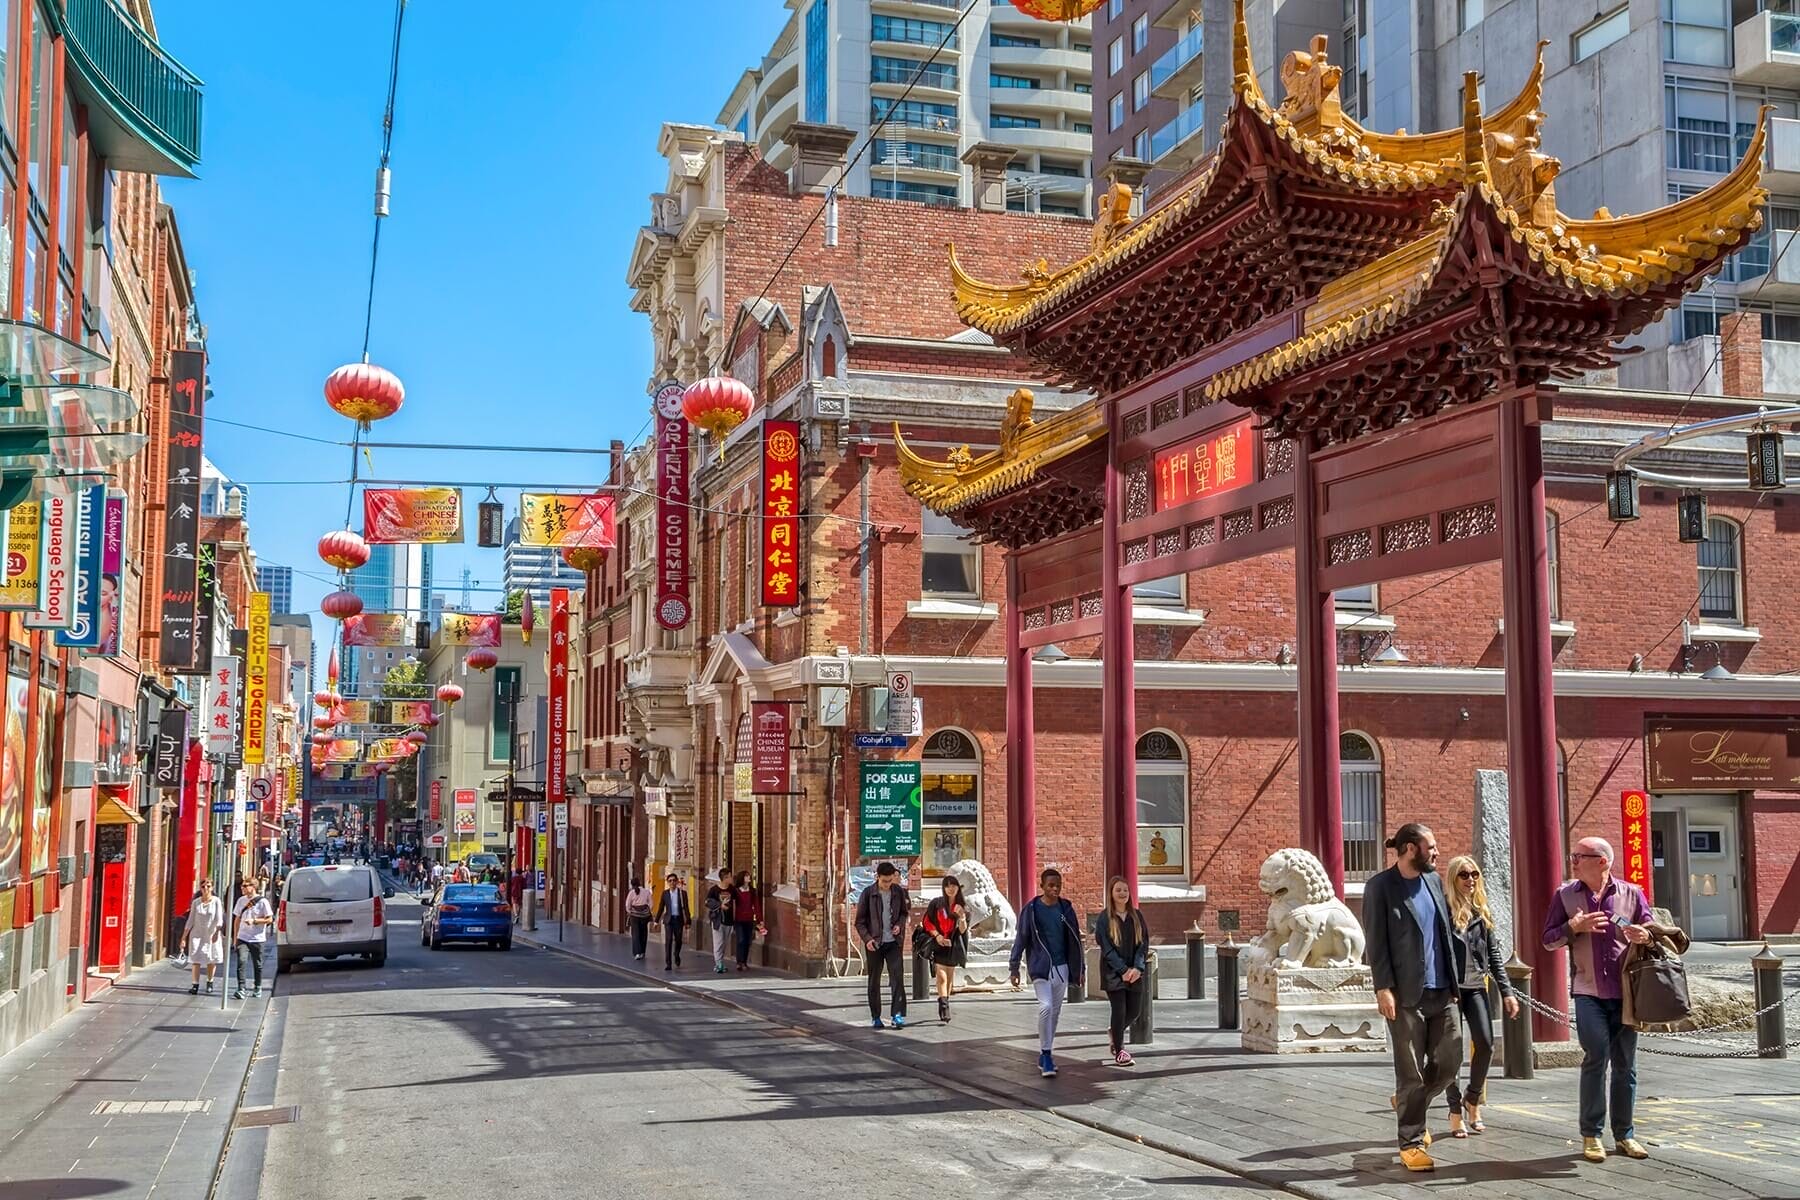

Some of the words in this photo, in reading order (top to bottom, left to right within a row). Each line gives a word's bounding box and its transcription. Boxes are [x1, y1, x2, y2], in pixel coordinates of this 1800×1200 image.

[665, 422, 682, 506] ORIENTAL
[48, 498, 64, 565] anguage
[413, 511, 456, 519] CHINESE
[767, 469, 794, 595] 北京同仁堂
[665, 515, 682, 592] GOURMET
[15, 579, 38, 588] 1366
[48, 569, 65, 621] School
[162, 614, 193, 626] Japanese
[552, 600, 567, 678] 大富貴
[252, 615, 266, 685] ORCHIDS
[250, 689, 265, 749] GARDEN
[554, 696, 563, 728] CHINA
[158, 733, 181, 781] shine
[554, 730, 562, 744] OF
[885, 736, 892, 744] Pl
[1728, 752, 1772, 765] melbourne
[553, 749, 562, 795] EMPRESS
[865, 786, 891, 800] 出售
[866, 774, 888, 783] FOR
[890, 773, 916, 783] SALE
[929, 803, 962, 811] Chinese
[1628, 820, 1645, 890] 北京同仁
